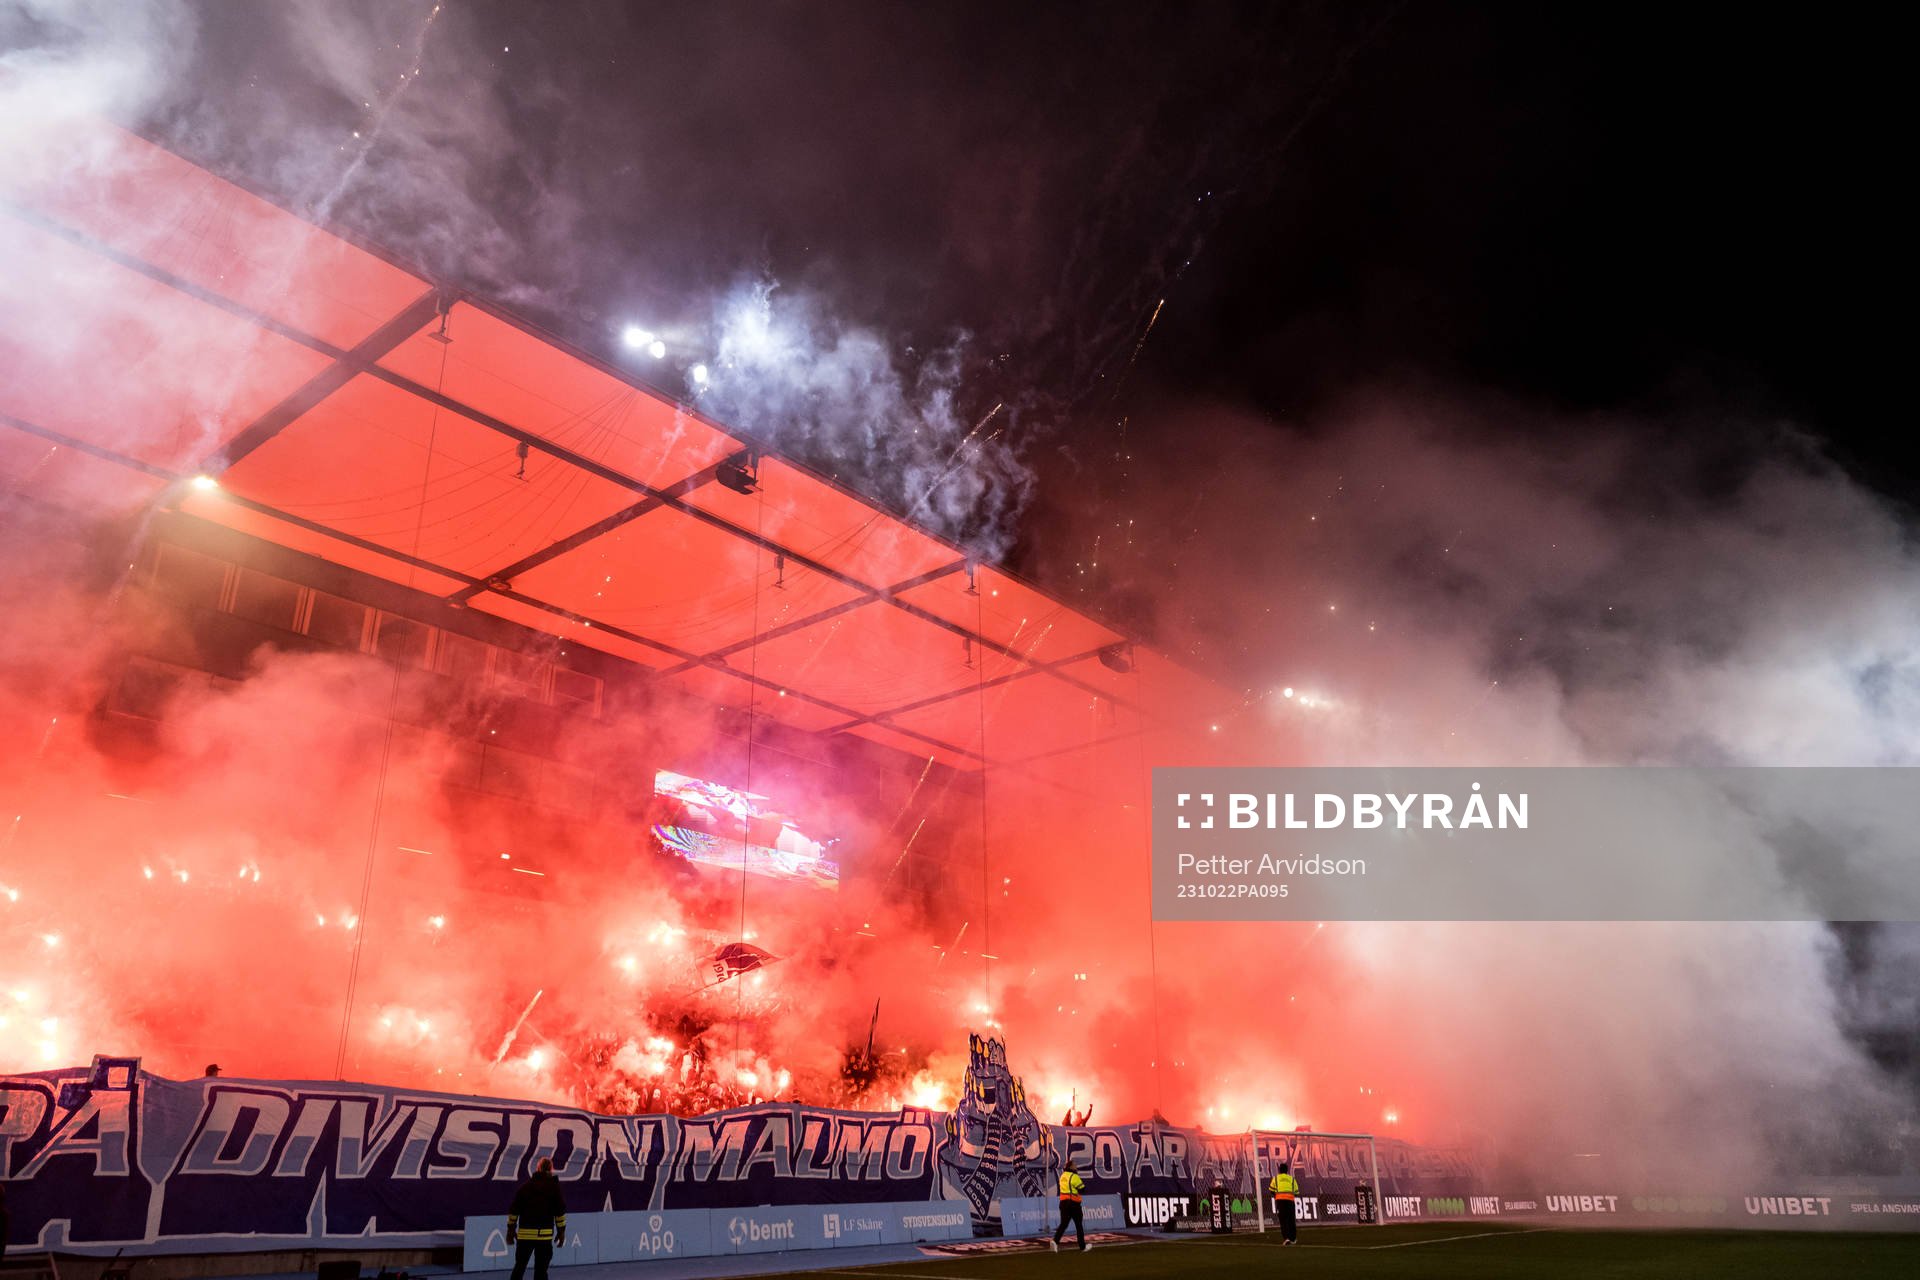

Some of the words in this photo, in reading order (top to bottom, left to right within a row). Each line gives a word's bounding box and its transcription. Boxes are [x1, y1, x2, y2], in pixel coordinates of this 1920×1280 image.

[178, 1085, 656, 1182] DIVISION
[674, 1109, 933, 1182] MALMÖ
[1069, 1132, 1123, 1180] 20
[1133, 1122, 1189, 1179] ÅR
[1128, 1196, 1190, 1224] UNIBET
[1212, 1193, 1222, 1229] SELECT
[1384, 1196, 1421, 1217] UNIBET
[1470, 1196, 1500, 1215] UNIBET
[1546, 1195, 1618, 1213] UNIBET
[1744, 1196, 1832, 1217] UNIBET
[1851, 1203, 1880, 1213] SPELA
[750, 1217, 795, 1241] bemt
[843, 1219, 856, 1232] LF
[857, 1216, 883, 1231] Skåne
[639, 1230, 675, 1255] ApQ
